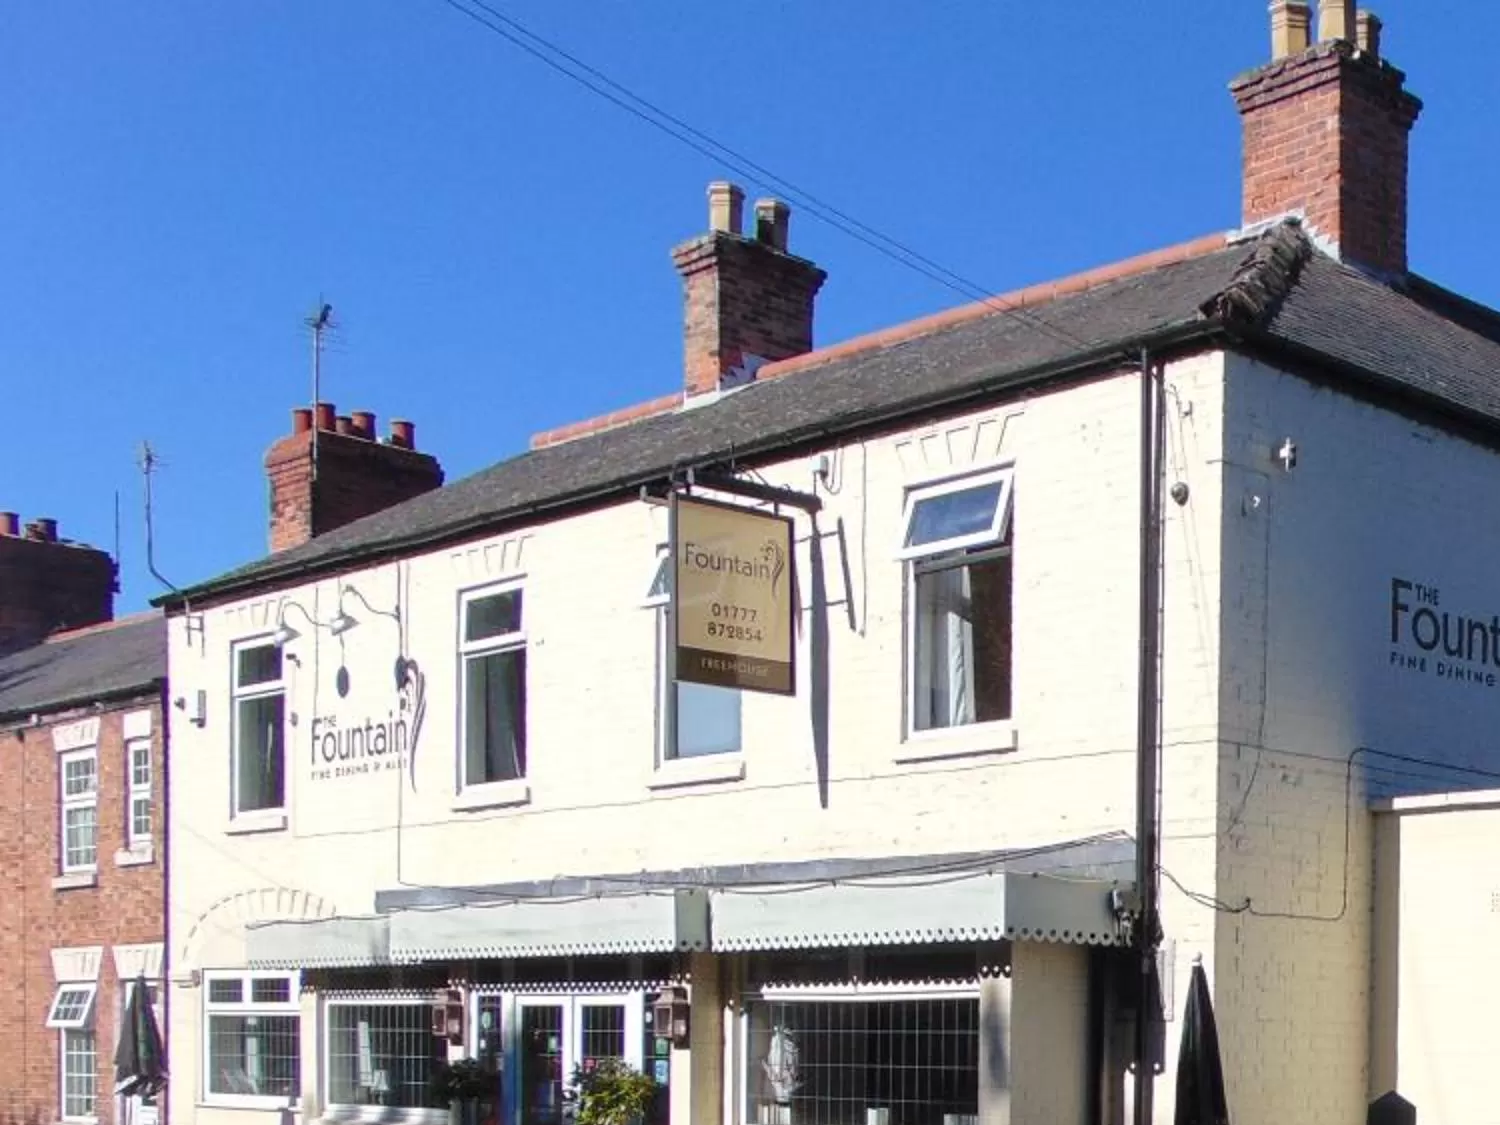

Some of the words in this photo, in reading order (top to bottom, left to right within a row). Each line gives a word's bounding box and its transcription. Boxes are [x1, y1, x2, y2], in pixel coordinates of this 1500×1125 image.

[685, 542, 770, 580] Fountain
[711, 602, 757, 622] 01777
[1414, 583, 1440, 606] THE
[1390, 651, 1427, 673] FINE
[1437, 662, 1497, 687] DINING
[311, 709, 407, 765] Fountain
